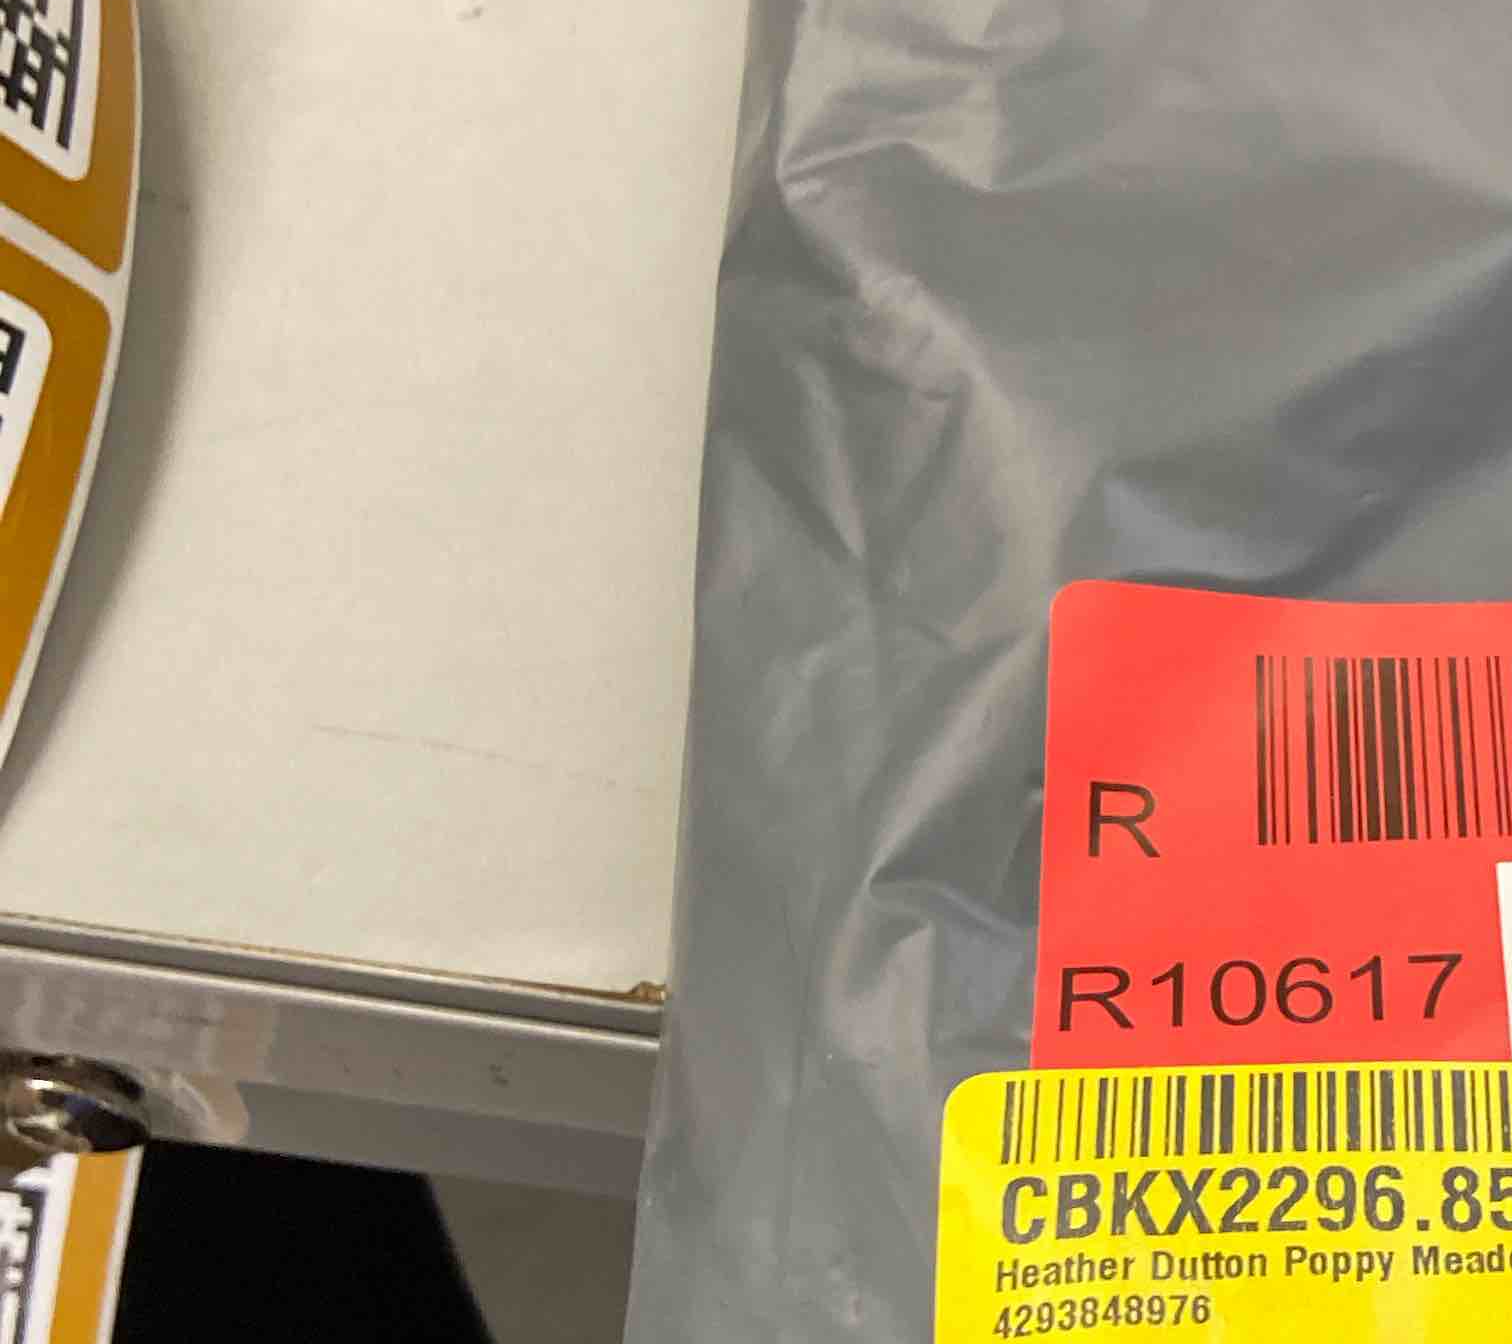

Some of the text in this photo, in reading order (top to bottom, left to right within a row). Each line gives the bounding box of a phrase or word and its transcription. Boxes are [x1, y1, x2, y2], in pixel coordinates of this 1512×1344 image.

[1088, 780, 1161, 858] R
[1058, 953, 1463, 1032] R10617
[995, 1251, 1136, 1293] Heather
[1151, 1249, 1267, 1282] Dutton
[1284, 1245, 1395, 1283] Poppy
[993, 1294, 1212, 1341] 4293848976
